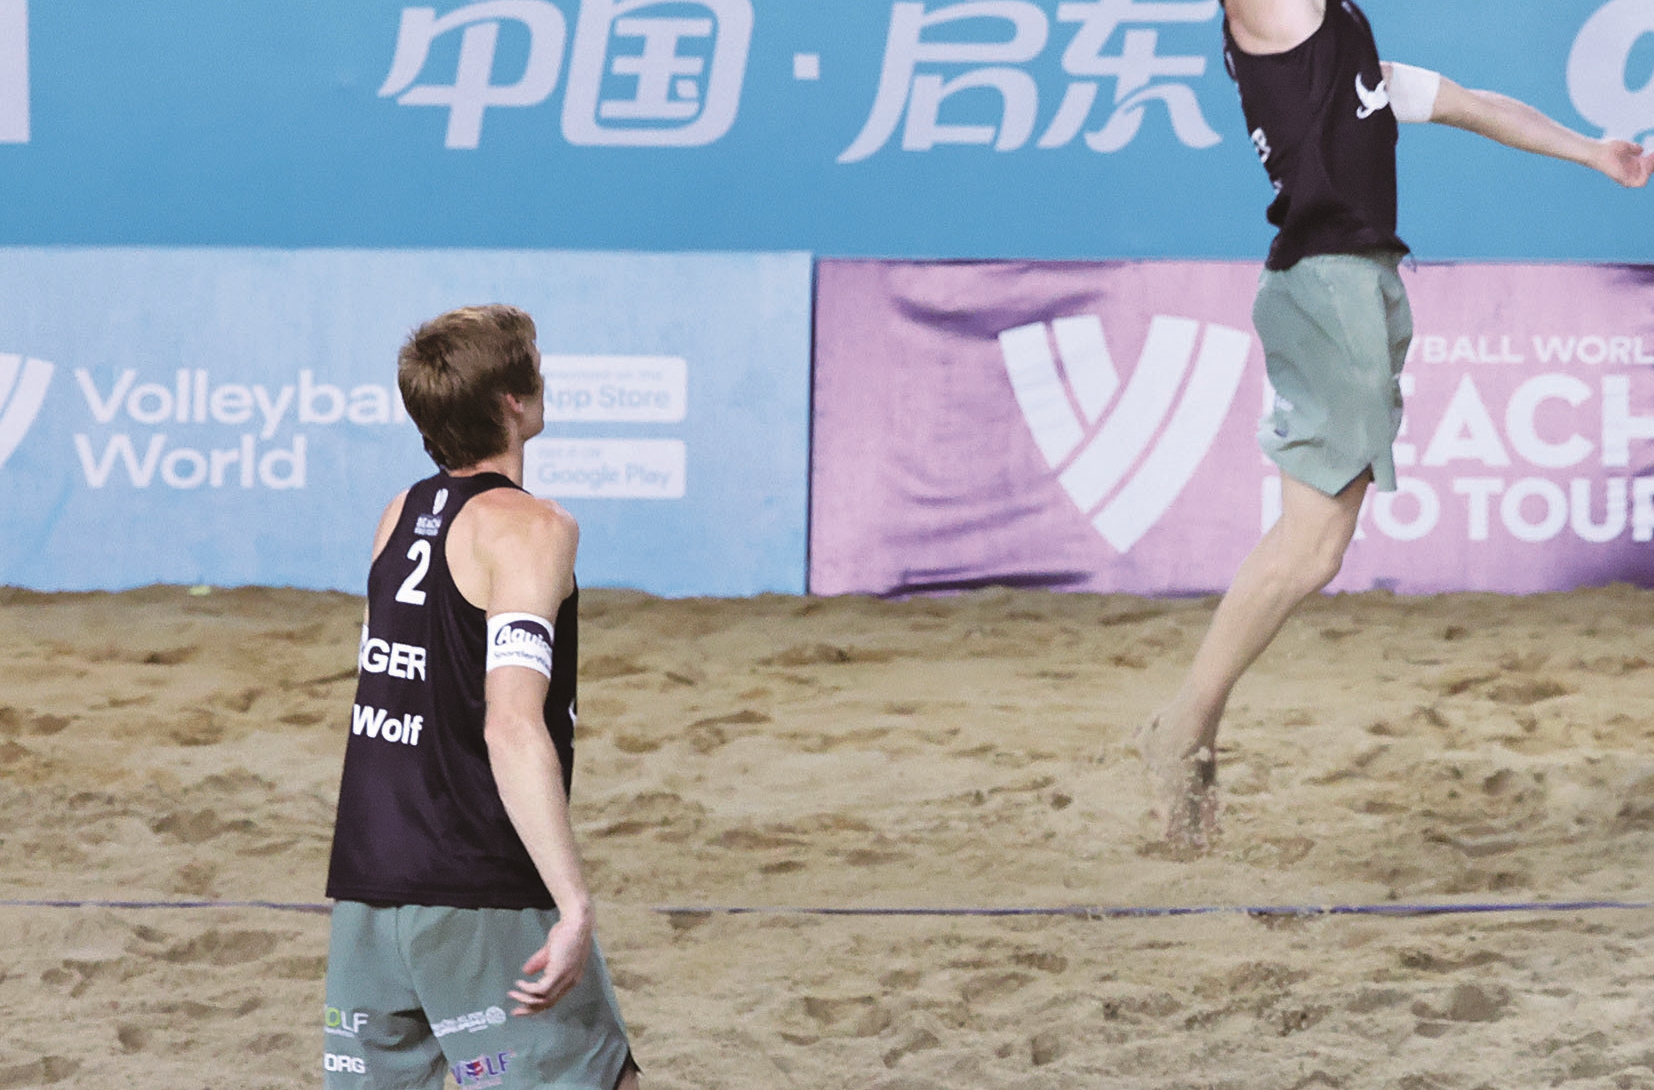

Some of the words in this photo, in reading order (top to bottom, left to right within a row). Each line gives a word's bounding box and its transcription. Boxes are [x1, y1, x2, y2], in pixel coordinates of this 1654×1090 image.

[73, 432, 308, 490] World
[395, 538, 432, 606] 2
[352, 703, 424, 746] Wolf
